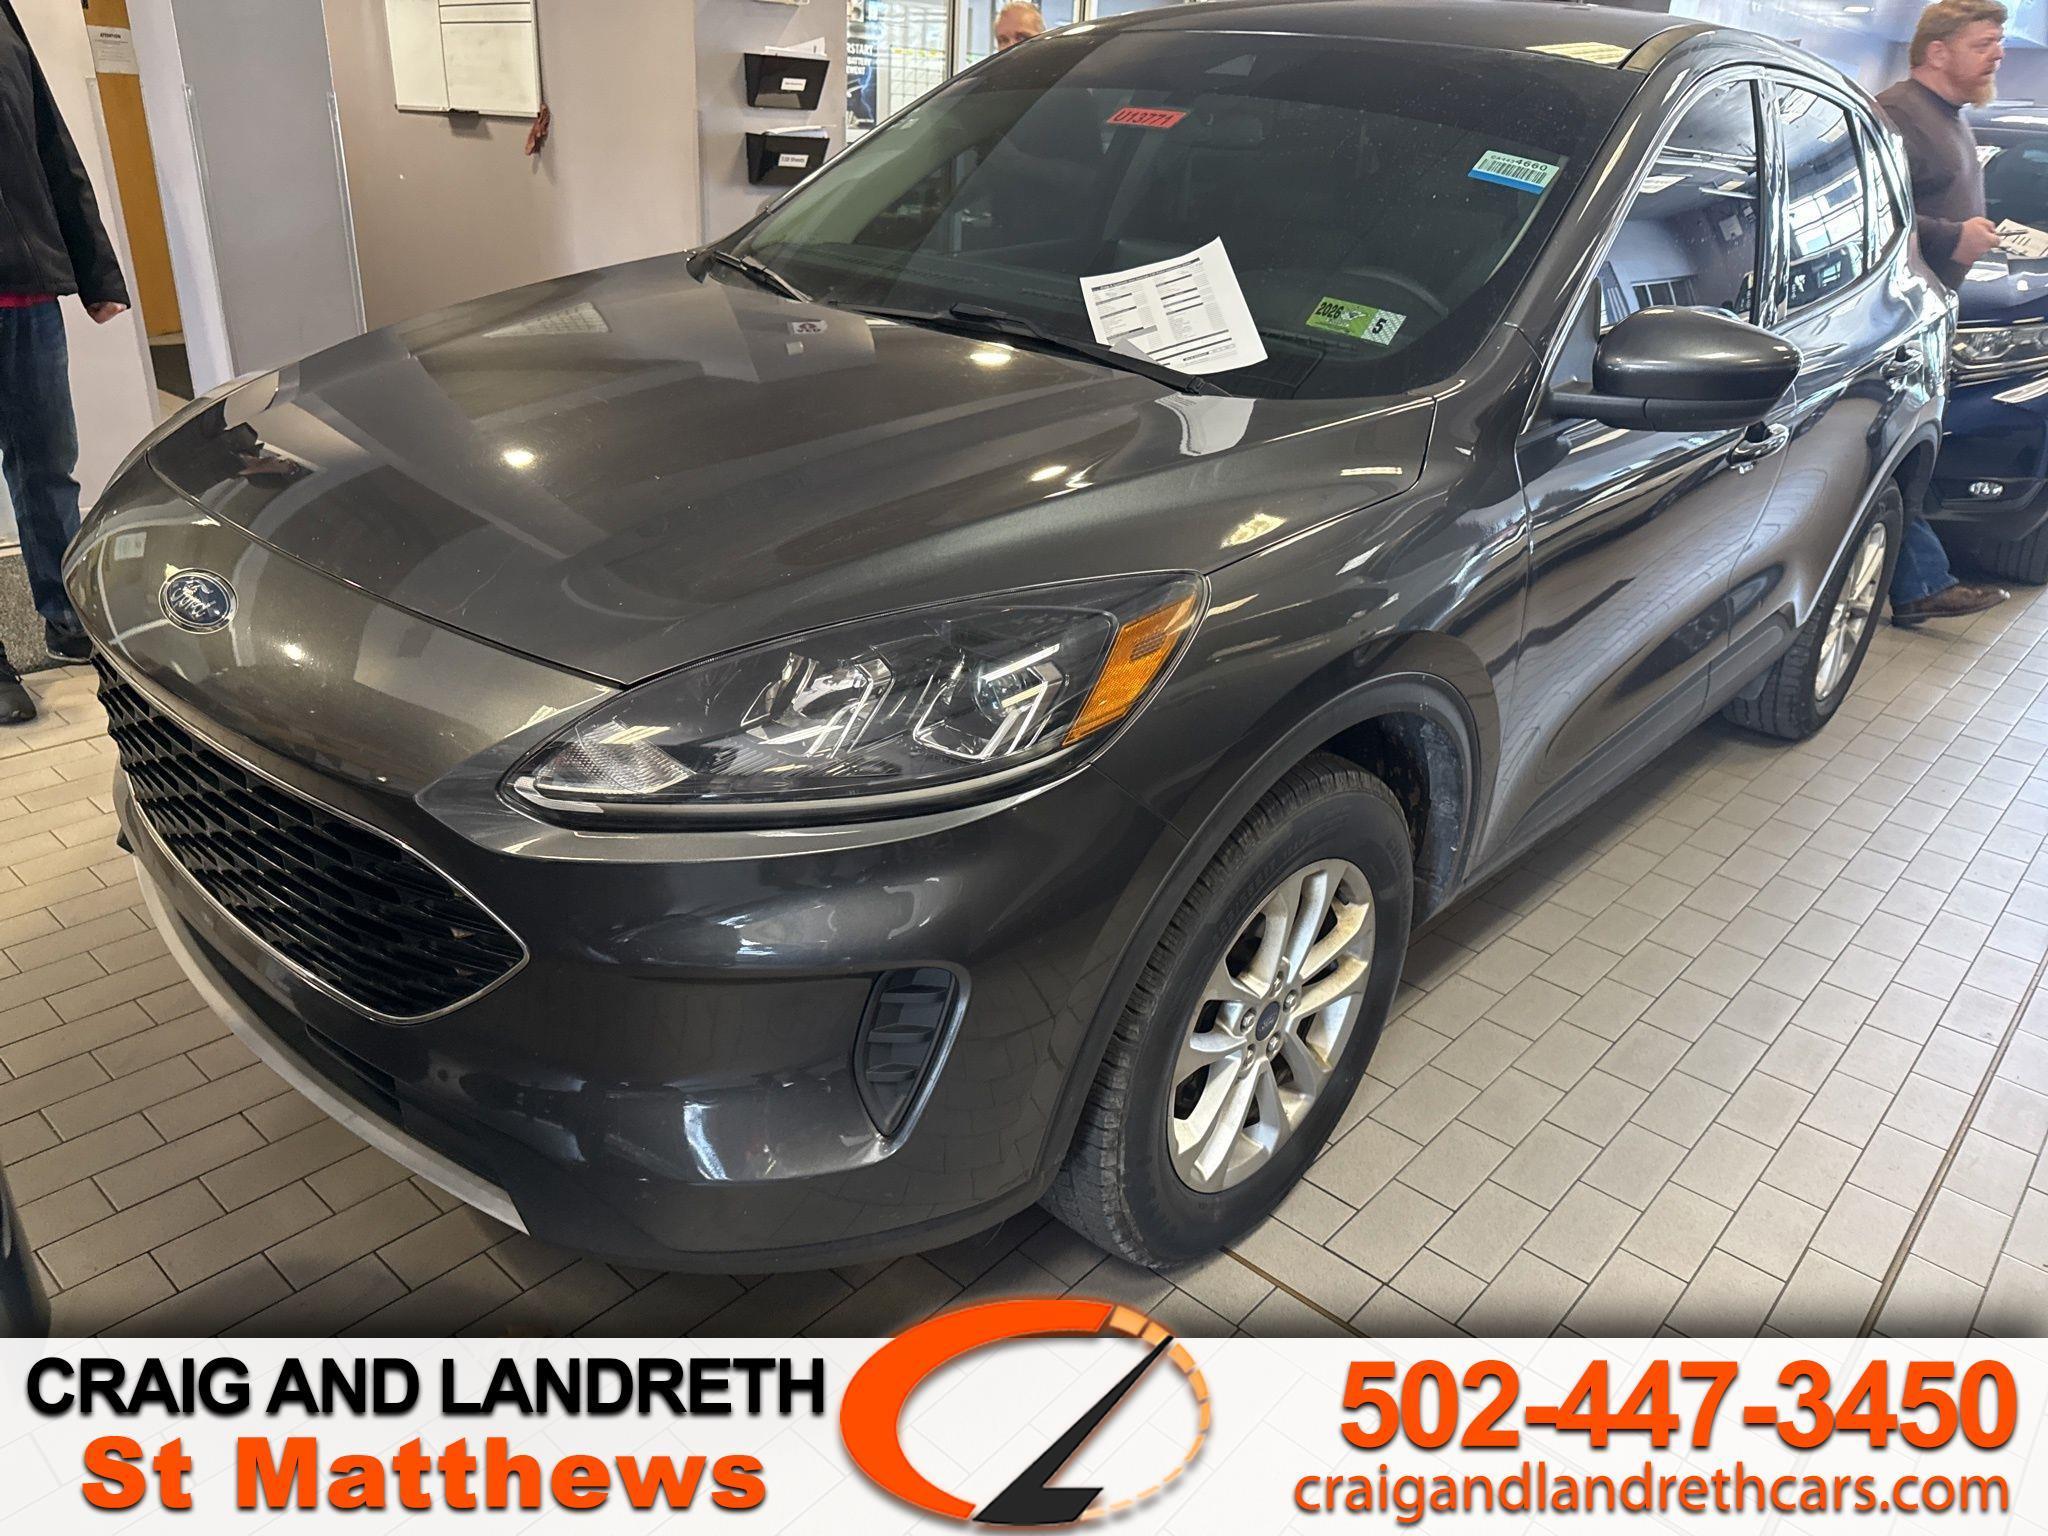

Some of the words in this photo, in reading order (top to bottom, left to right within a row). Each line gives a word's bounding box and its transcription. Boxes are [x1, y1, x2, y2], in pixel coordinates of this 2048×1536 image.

[1315, 302, 1345, 320] 2026
[1372, 317, 1387, 335] 5
[170, 578, 217, 620] Ford
